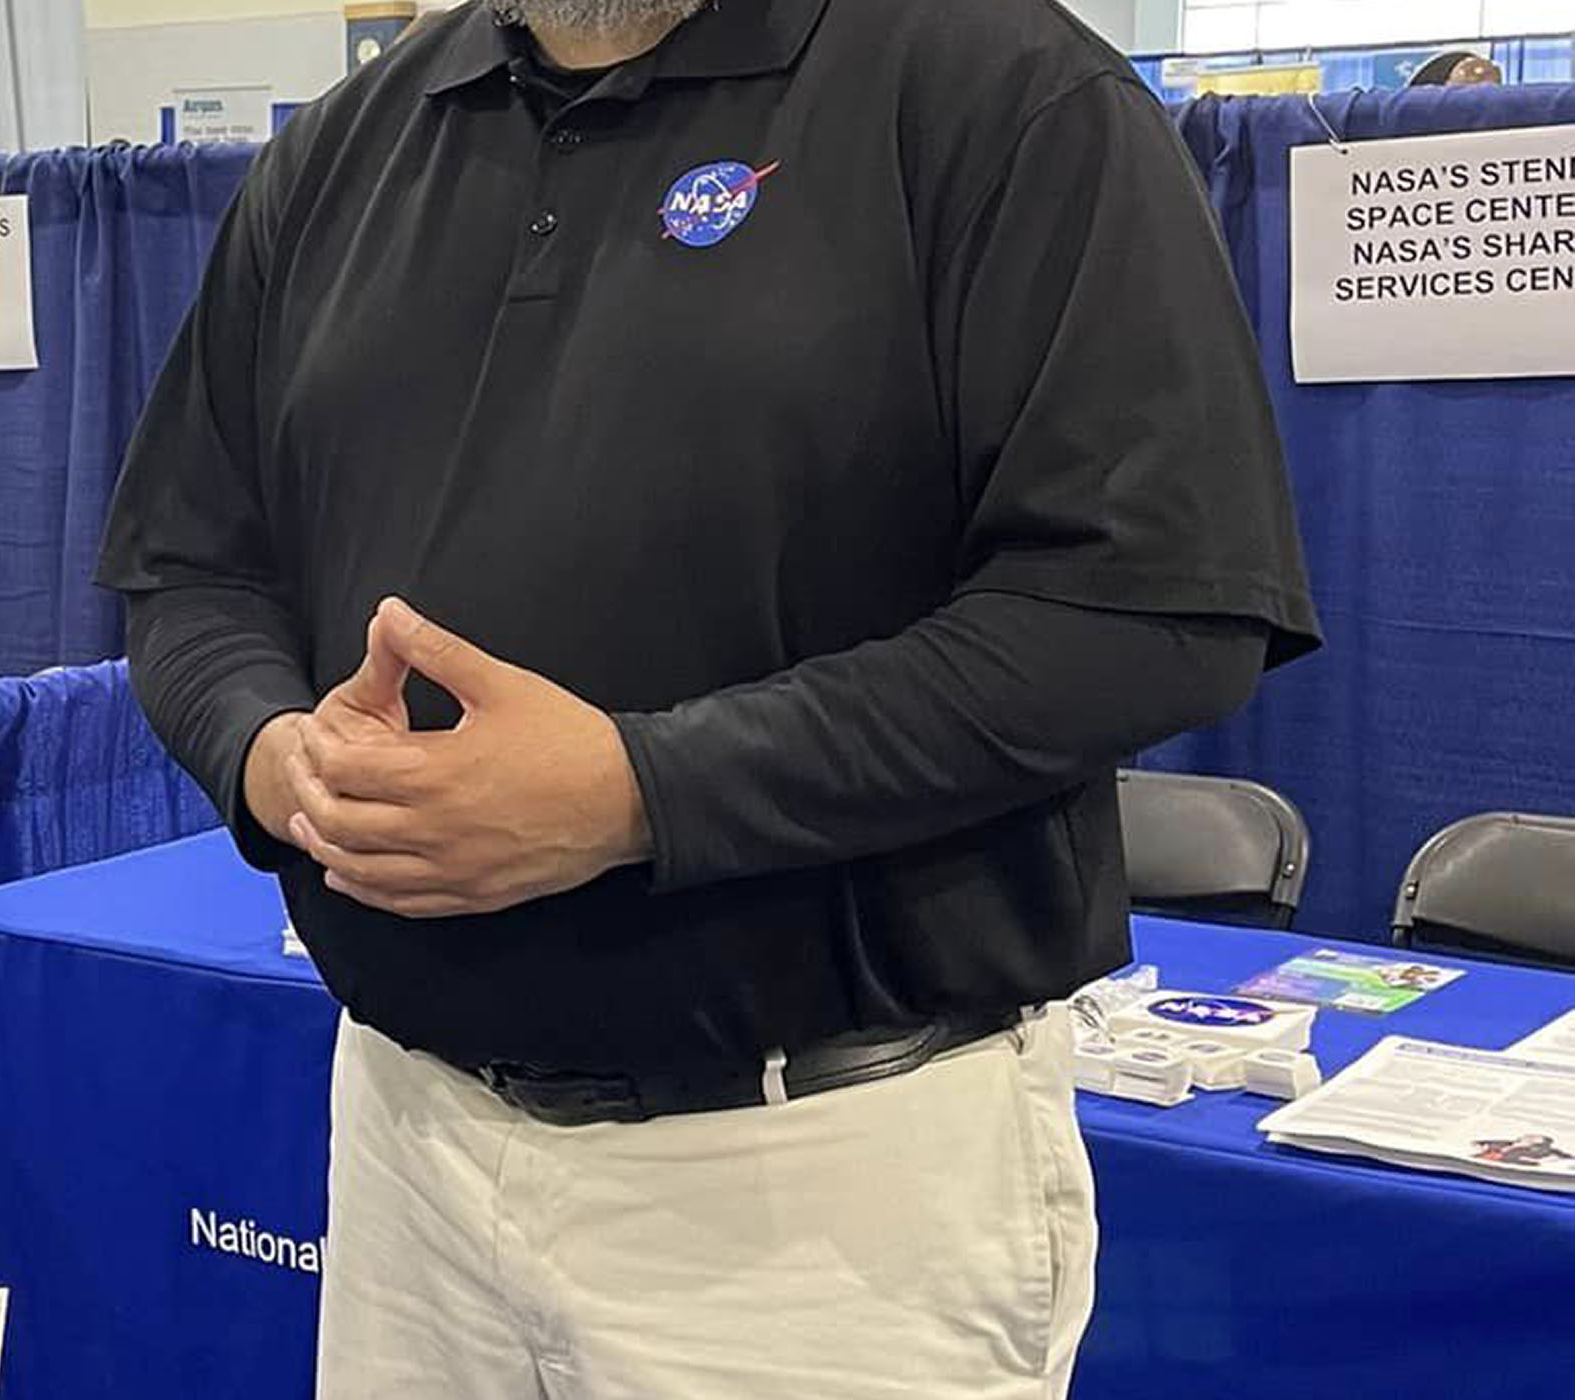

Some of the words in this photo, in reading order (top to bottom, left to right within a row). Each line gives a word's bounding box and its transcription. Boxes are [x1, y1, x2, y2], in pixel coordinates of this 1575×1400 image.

[1352, 164, 1469, 196] NASA'S
[1481, 157, 1575, 186] STEN
[670, 190, 747, 214] NASA
[1347, 202, 1454, 231] SPACE
[1353, 235, 1471, 265] NASA'S
[1336, 269, 1494, 301] SERVICES
[1506, 266, 1574, 293] CEN
